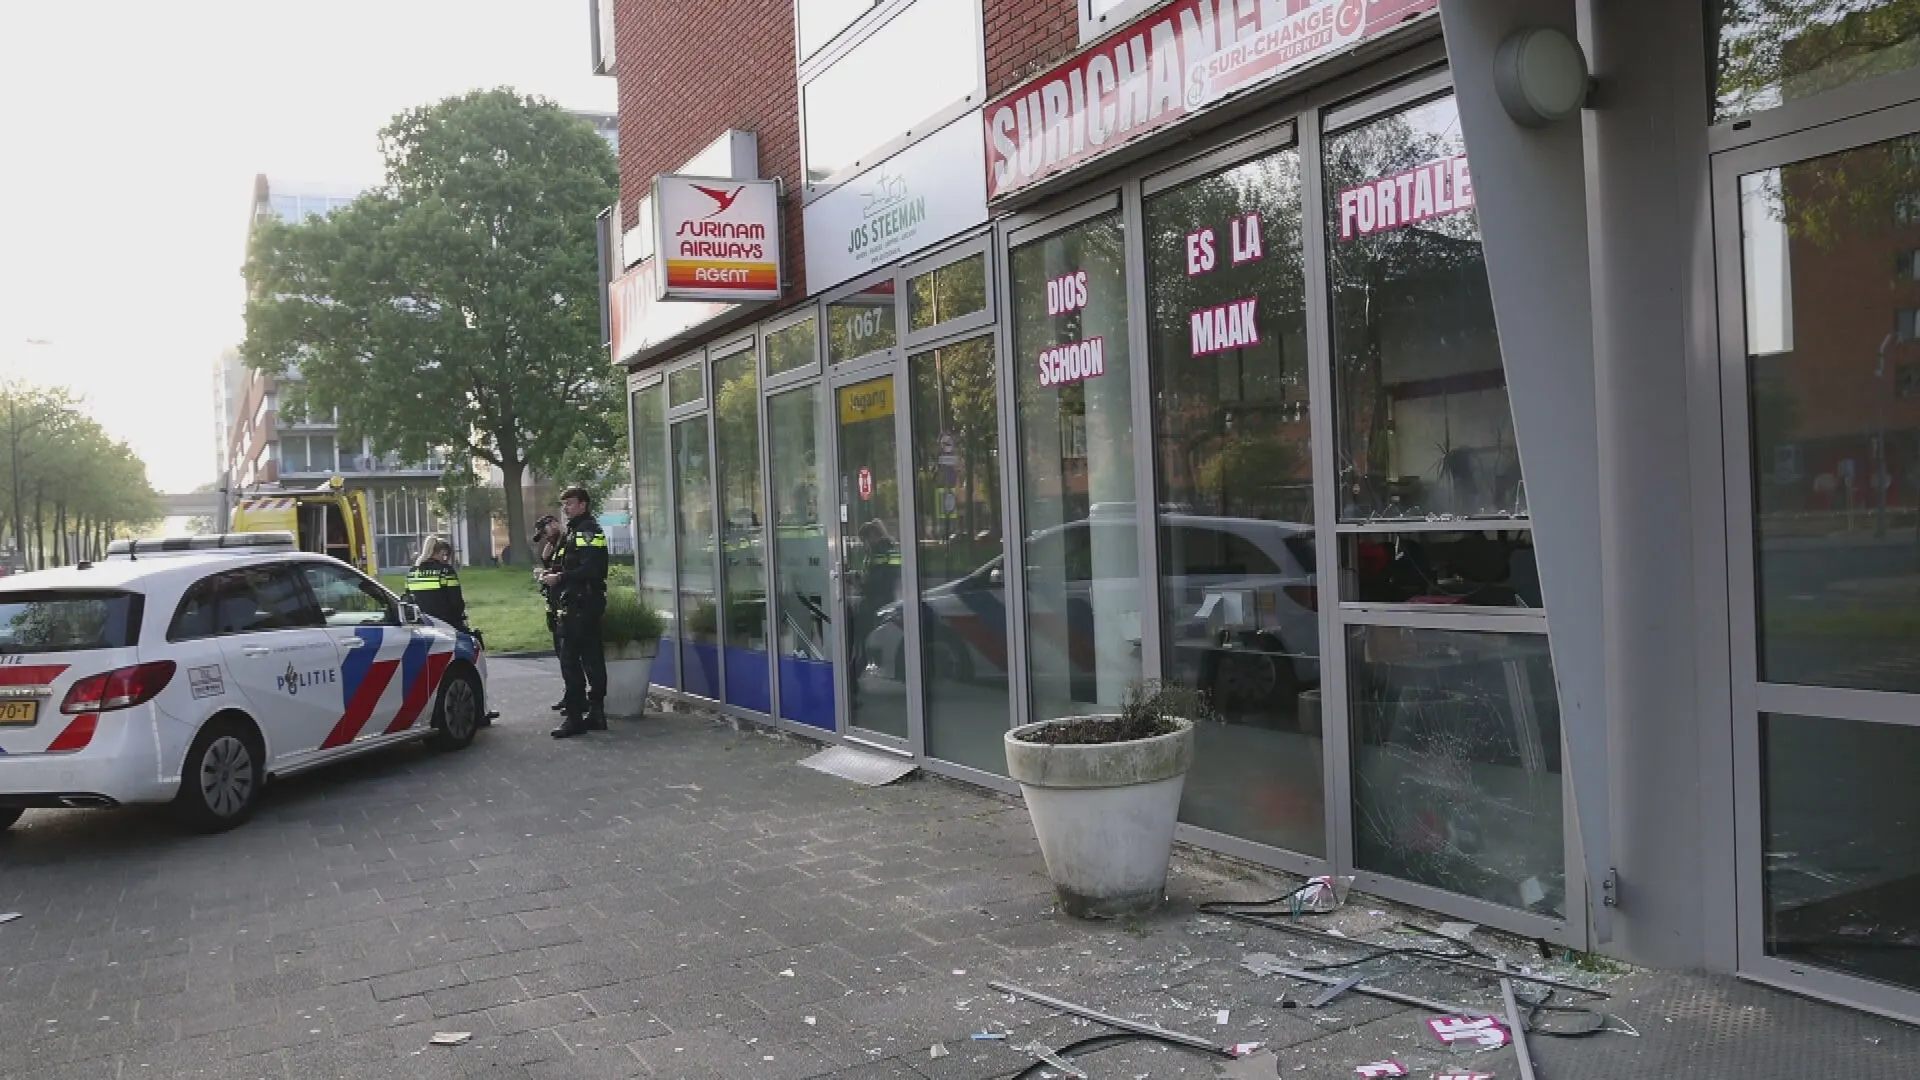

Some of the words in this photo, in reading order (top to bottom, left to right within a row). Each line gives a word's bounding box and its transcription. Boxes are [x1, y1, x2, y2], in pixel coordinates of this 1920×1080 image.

[1208, 4, 1333, 75] SURI-CHANGE
[676, 221, 765, 240] SURINAM
[848, 224, 869, 253] JOS
[871, 195, 926, 243] STEEMAN
[680, 241, 764, 259] AIRWAYS
[1047, 271, 1087, 315] DIOS
[1187, 228, 1216, 275] ES
[1232, 214, 1262, 264] LA
[695, 267, 750, 283] AGENT
[846, 306, 882, 344] 1067
[1039, 337, 1103, 386] SCHOON
[1191, 299, 1259, 354] MAAK
[277, 668, 336, 695] POLITIE
